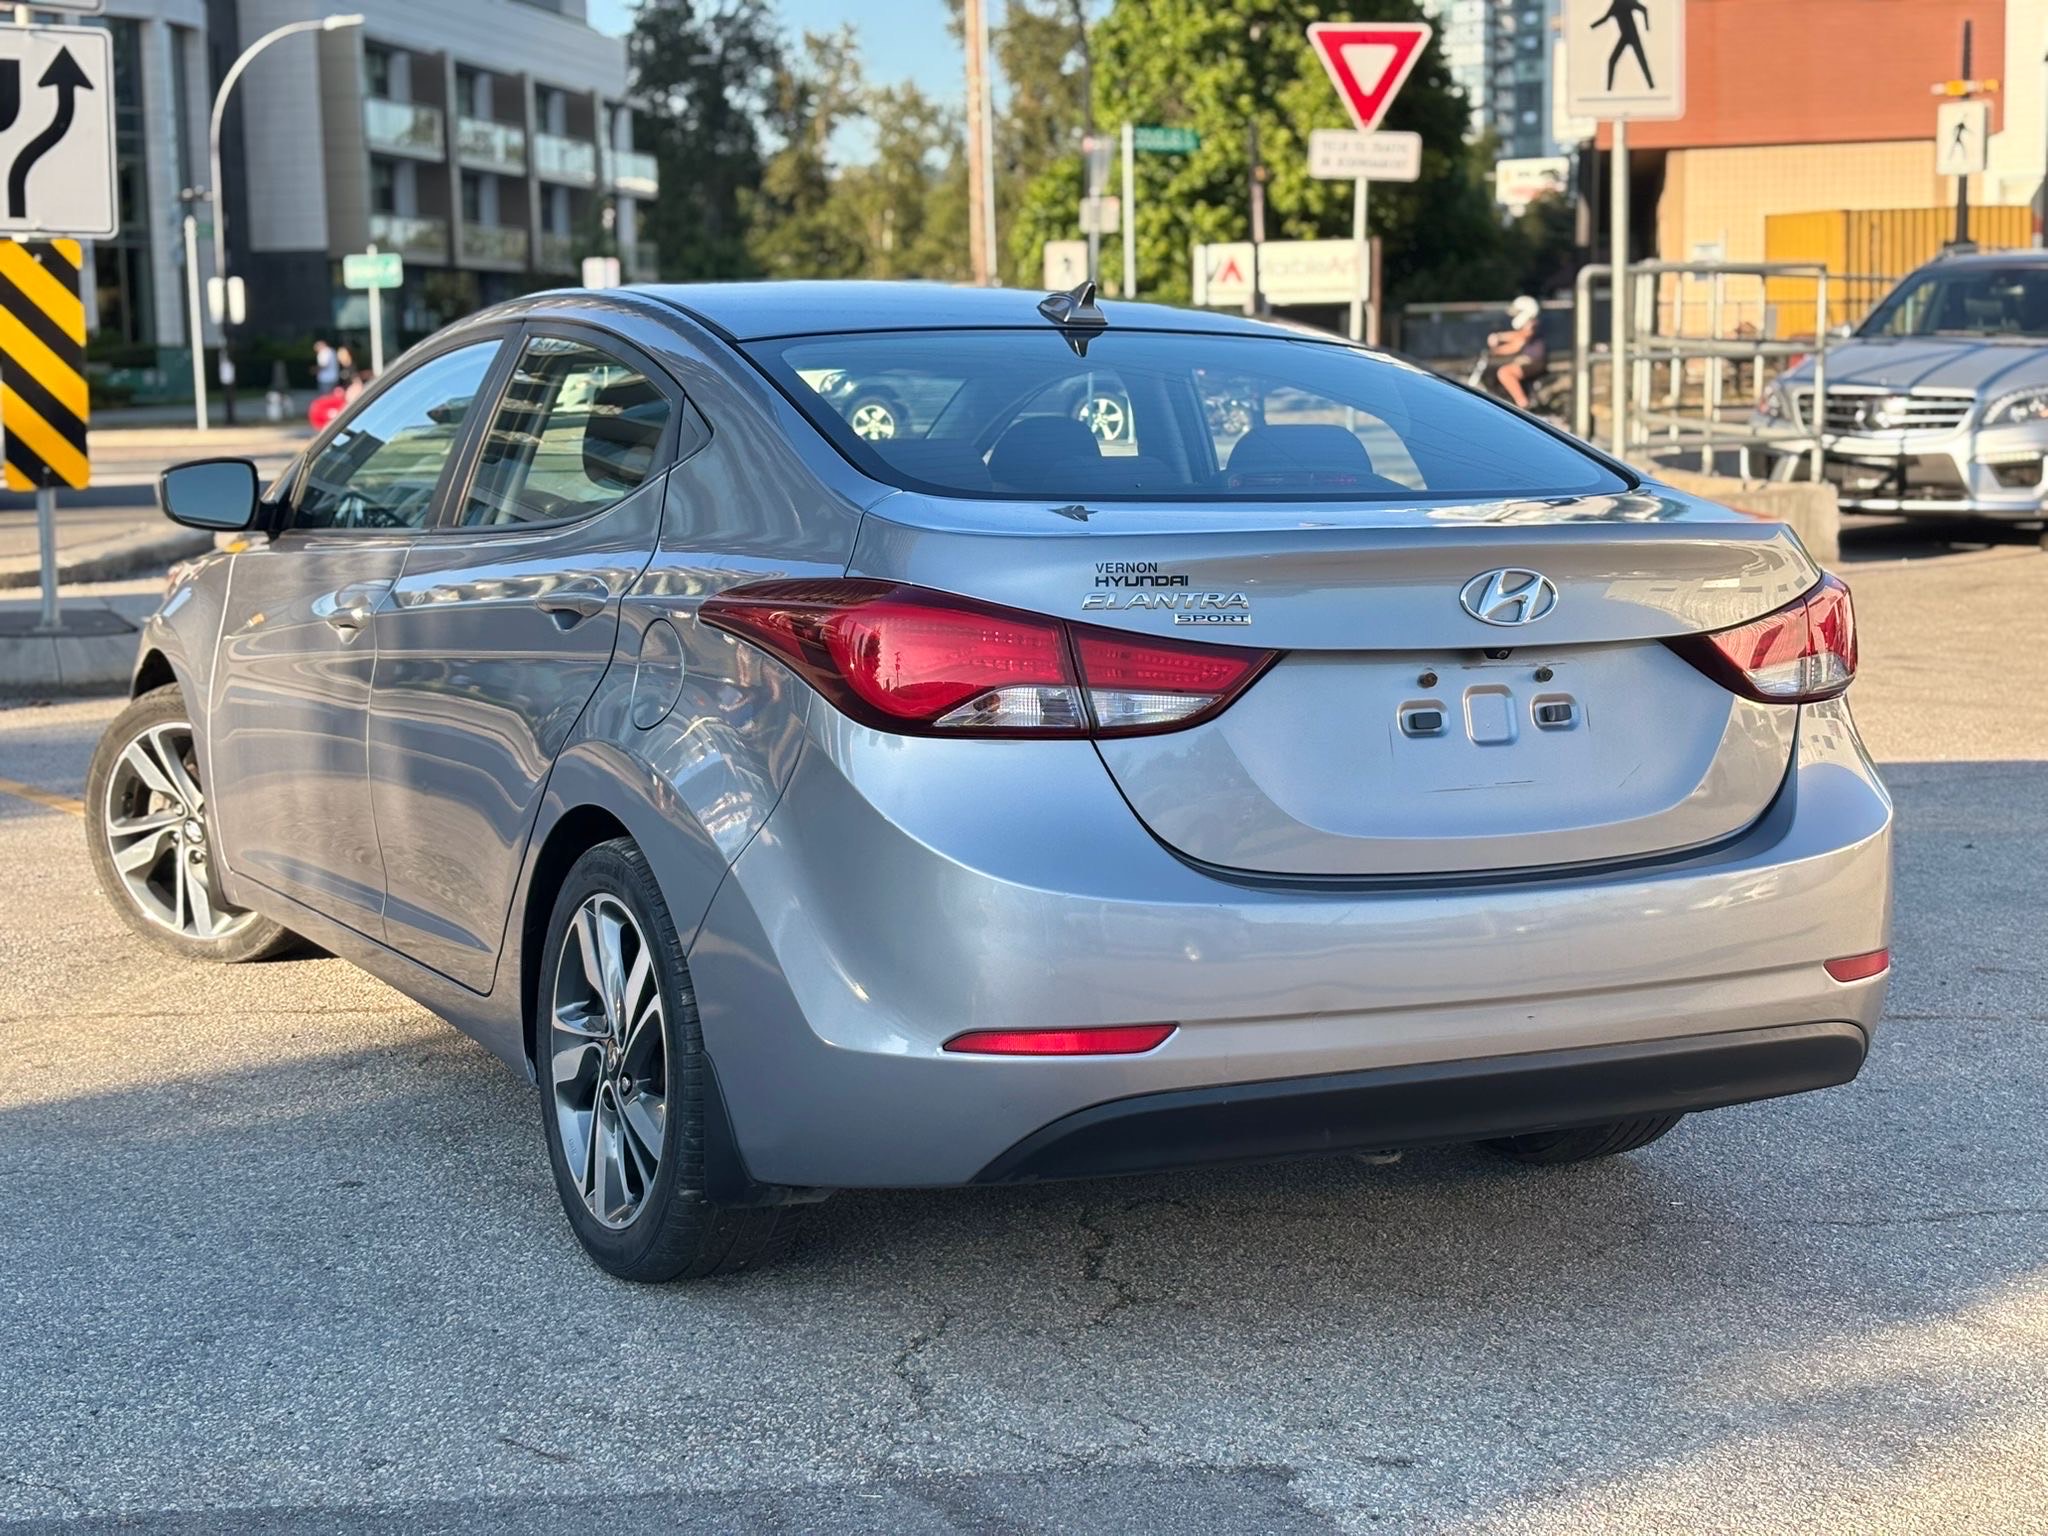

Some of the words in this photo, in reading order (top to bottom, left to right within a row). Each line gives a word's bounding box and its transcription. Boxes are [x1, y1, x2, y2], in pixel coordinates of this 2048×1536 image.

[1095, 562, 1158, 574] VERNON
[1095, 575, 1189, 587] HYUNDAI
[1081, 591, 1249, 610] ELANTRA
[1177, 614, 1250, 623] SPORT
